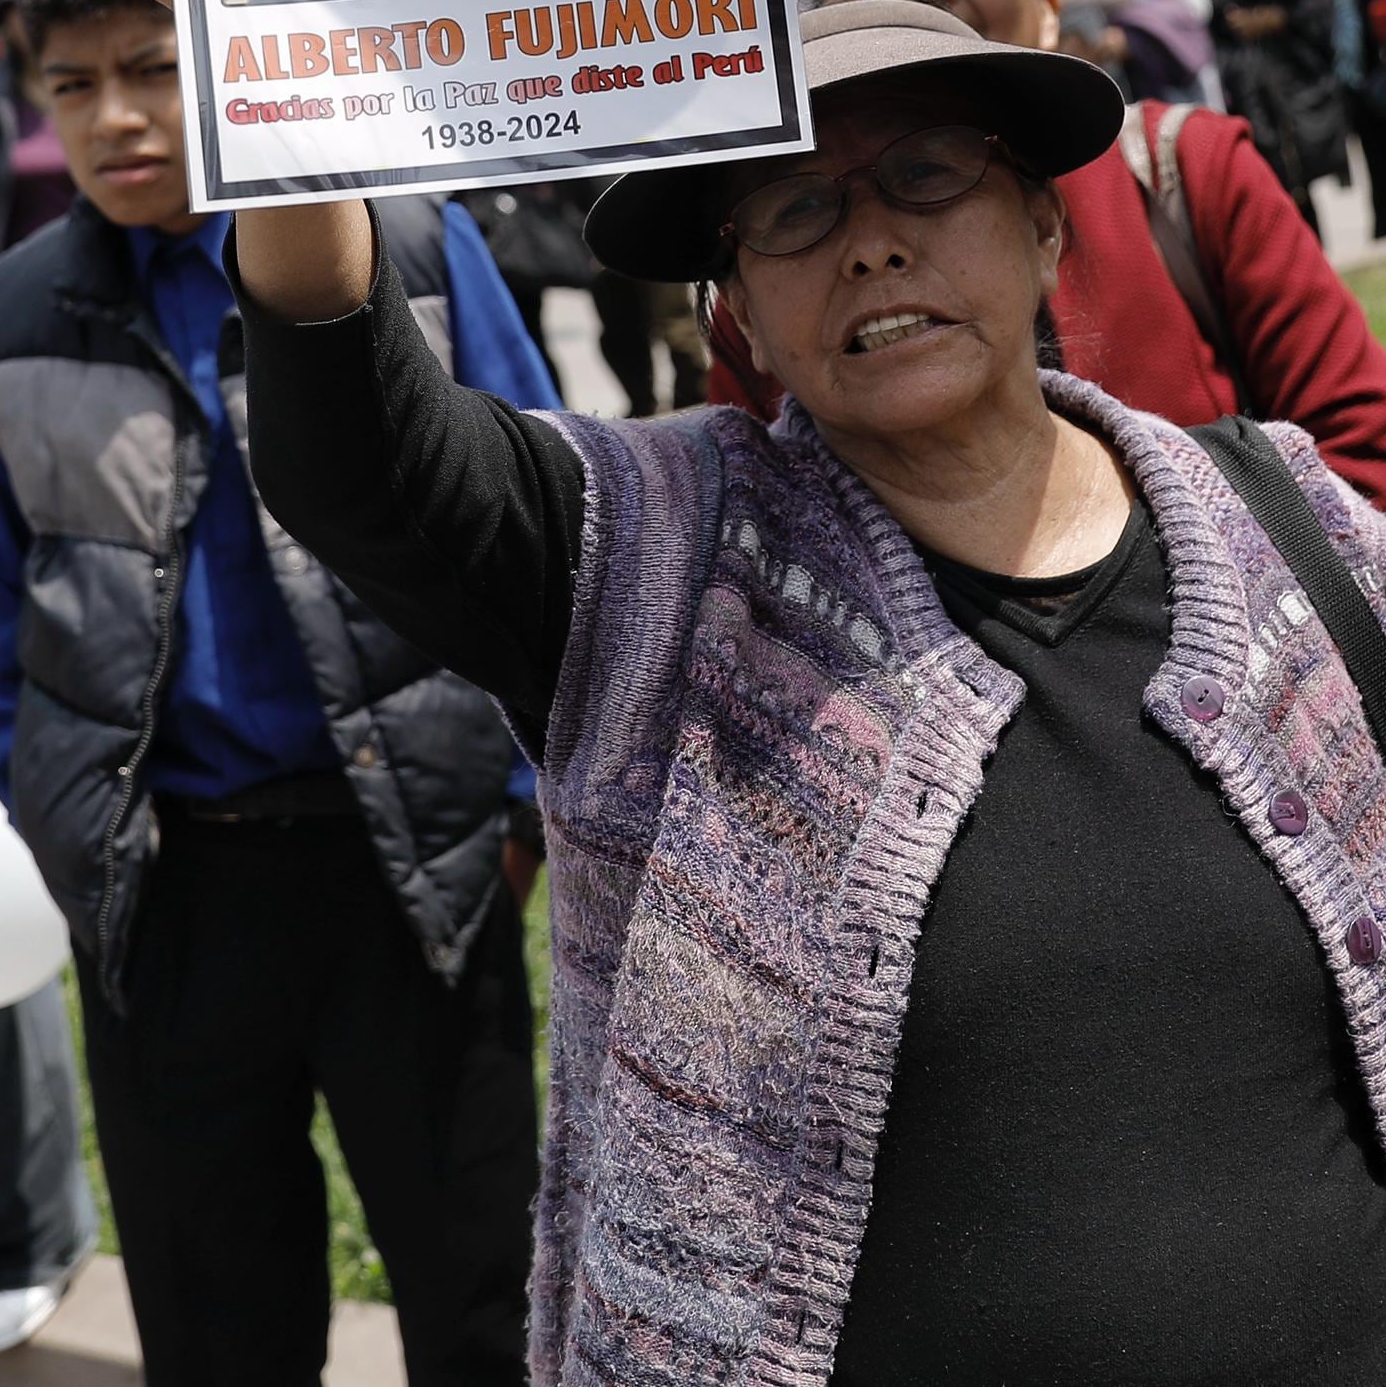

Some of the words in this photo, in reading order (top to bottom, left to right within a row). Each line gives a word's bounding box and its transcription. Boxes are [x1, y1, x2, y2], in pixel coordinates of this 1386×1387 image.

[223, 17, 465, 83] ALBERTO
[225, 95, 335, 125] Gracias
[343, 92, 394, 121] por
[403, 85, 434, 112] la
[444, 81, 499, 109] Paz
[507, 75, 562, 104] que
[571, 64, 644, 94] diste
[653, 55, 684, 84] al
[692, 45, 764, 80] Perú
[421, 110, 581, 150] 1938-2024
